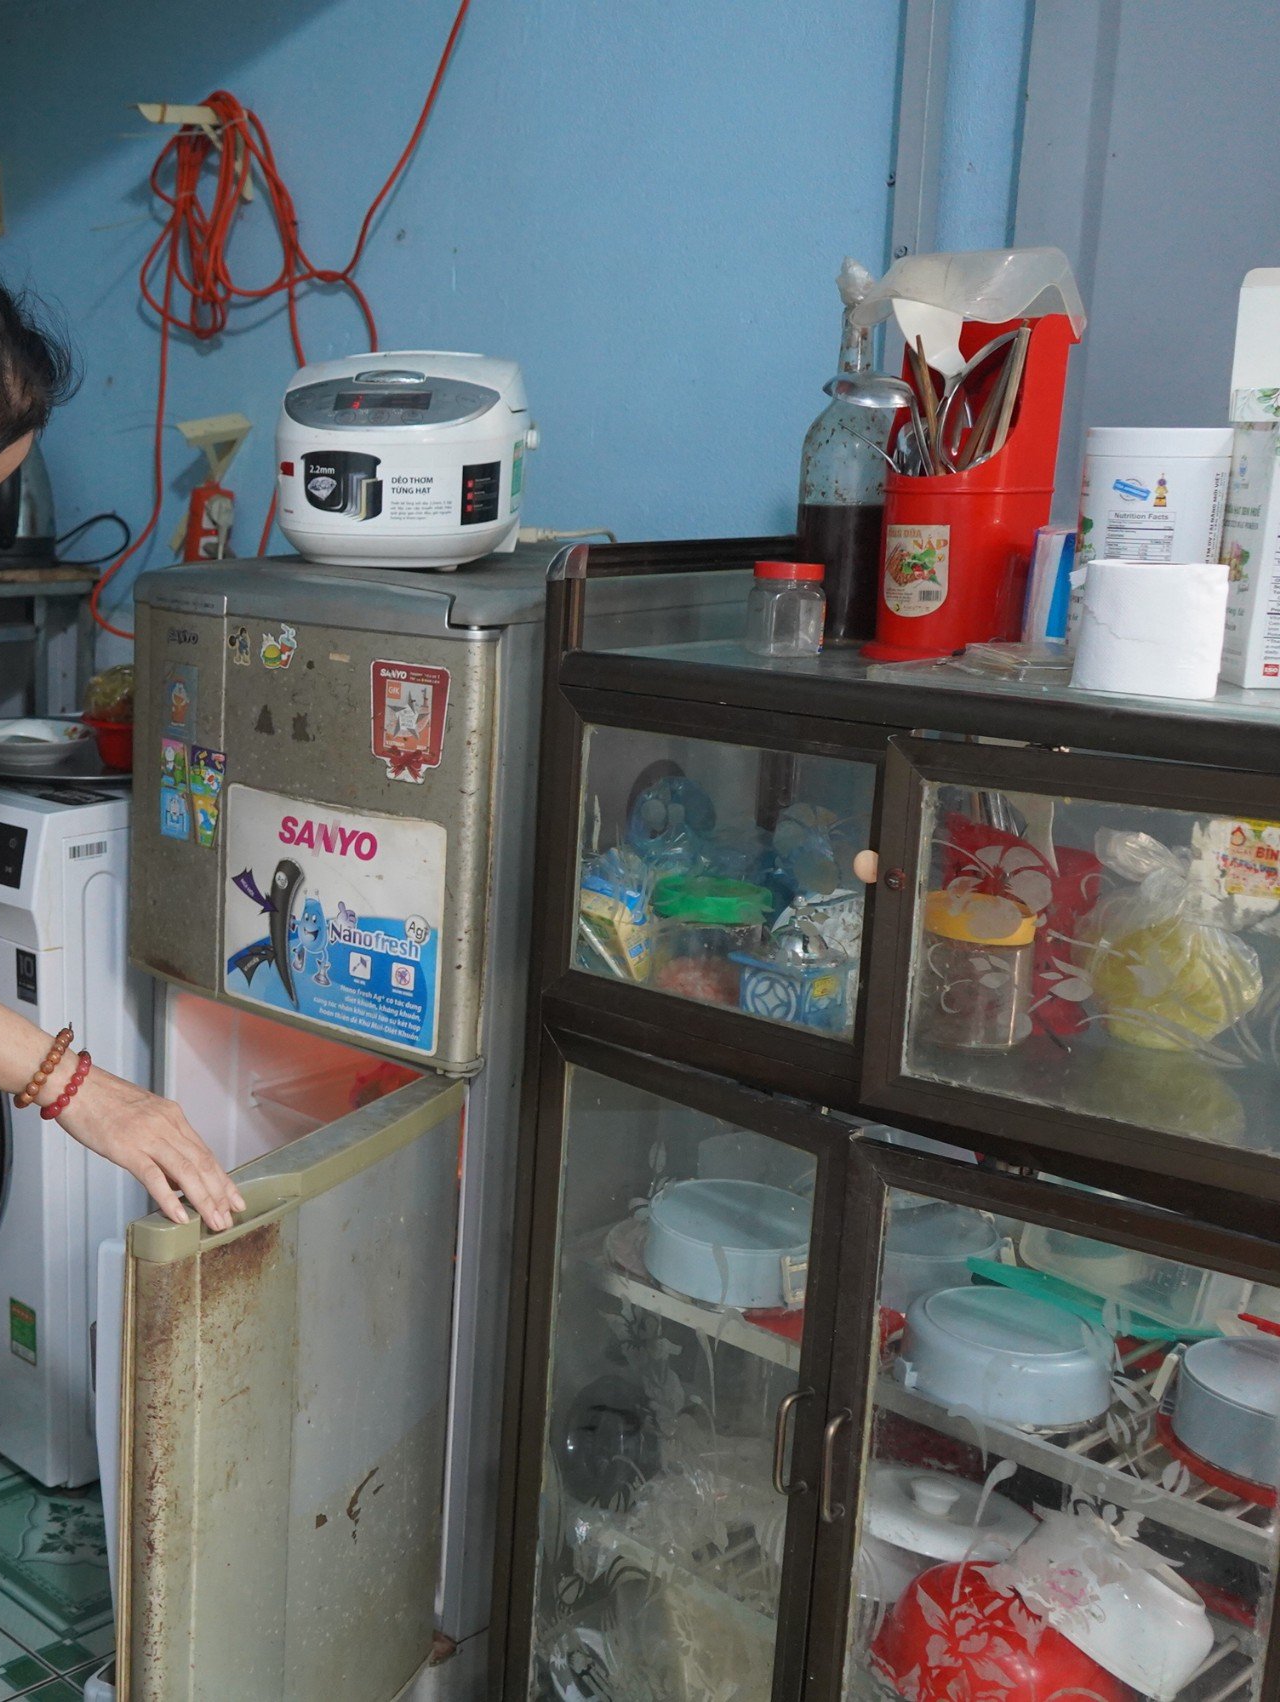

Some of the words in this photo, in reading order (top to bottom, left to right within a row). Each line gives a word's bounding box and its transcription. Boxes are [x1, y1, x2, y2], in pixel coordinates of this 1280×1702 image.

[309, 464, 335, 475] 2.2mm
[1114, 512, 1146, 520] Nutrition
[380, 667, 407, 679] SANYO
[278, 815, 378, 861] SANYO
[357, 988, 373, 999] fresh
